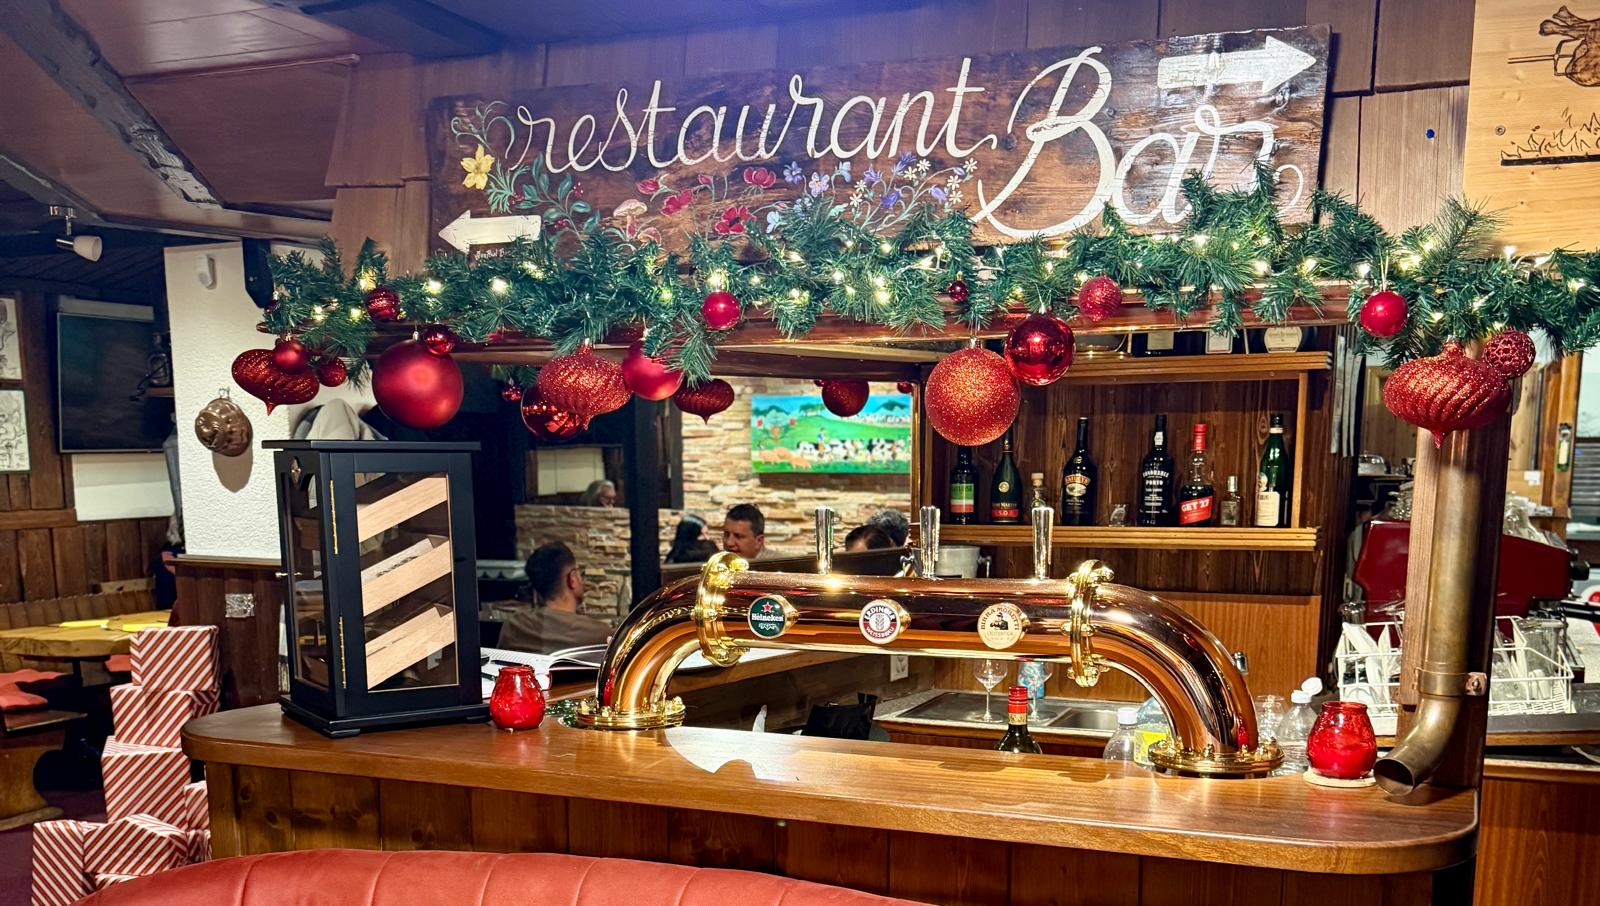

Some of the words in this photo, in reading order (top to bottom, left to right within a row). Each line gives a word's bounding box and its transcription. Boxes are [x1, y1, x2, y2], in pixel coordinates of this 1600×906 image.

[510, 57, 998, 174] restaurant
[968, 46, 1303, 238] Bar
[1181, 501, 1198, 512] GET
[1199, 498, 1210, 508] 27
[751, 612, 784, 622] Heineken
[864, 605, 896, 620] ERDINGER
